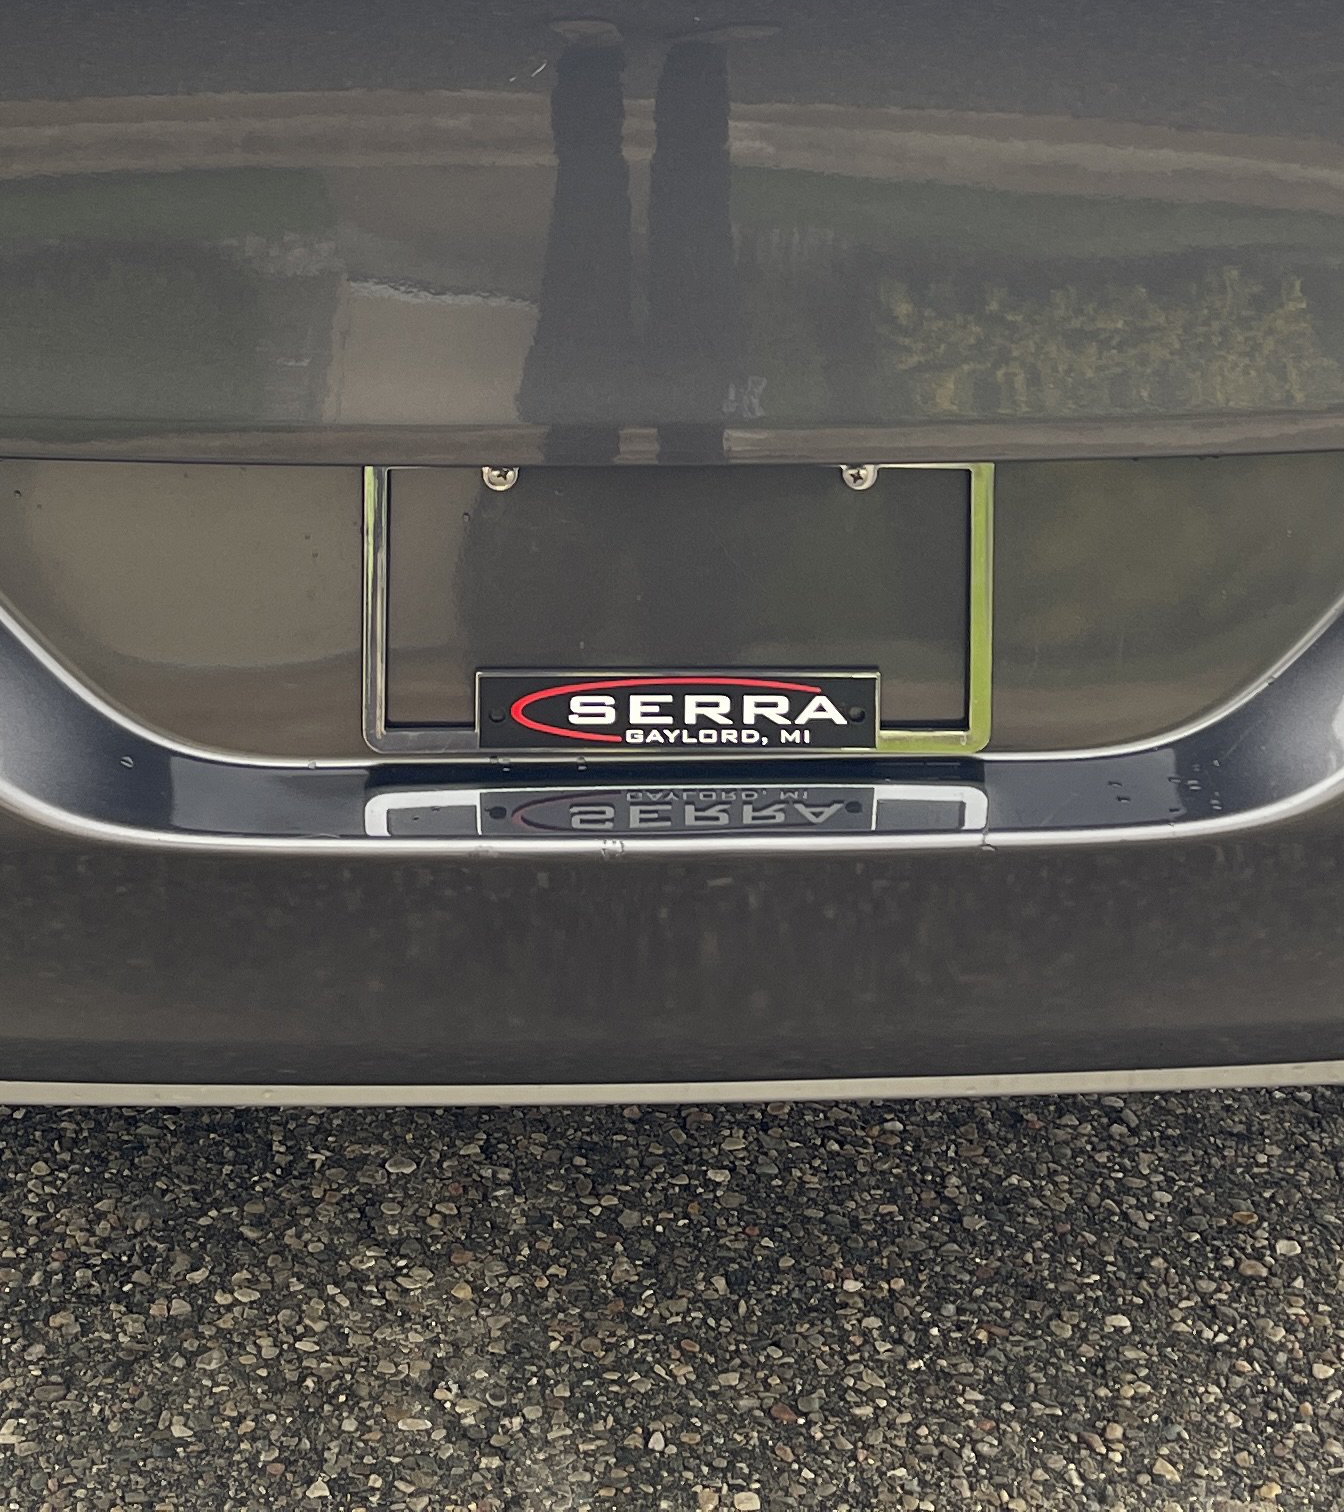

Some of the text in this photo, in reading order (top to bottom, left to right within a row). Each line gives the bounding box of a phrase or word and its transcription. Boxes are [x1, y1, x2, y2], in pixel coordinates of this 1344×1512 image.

[568, 694, 848, 725] SERRA
[625, 728, 811, 746] GAYLORD, MI
